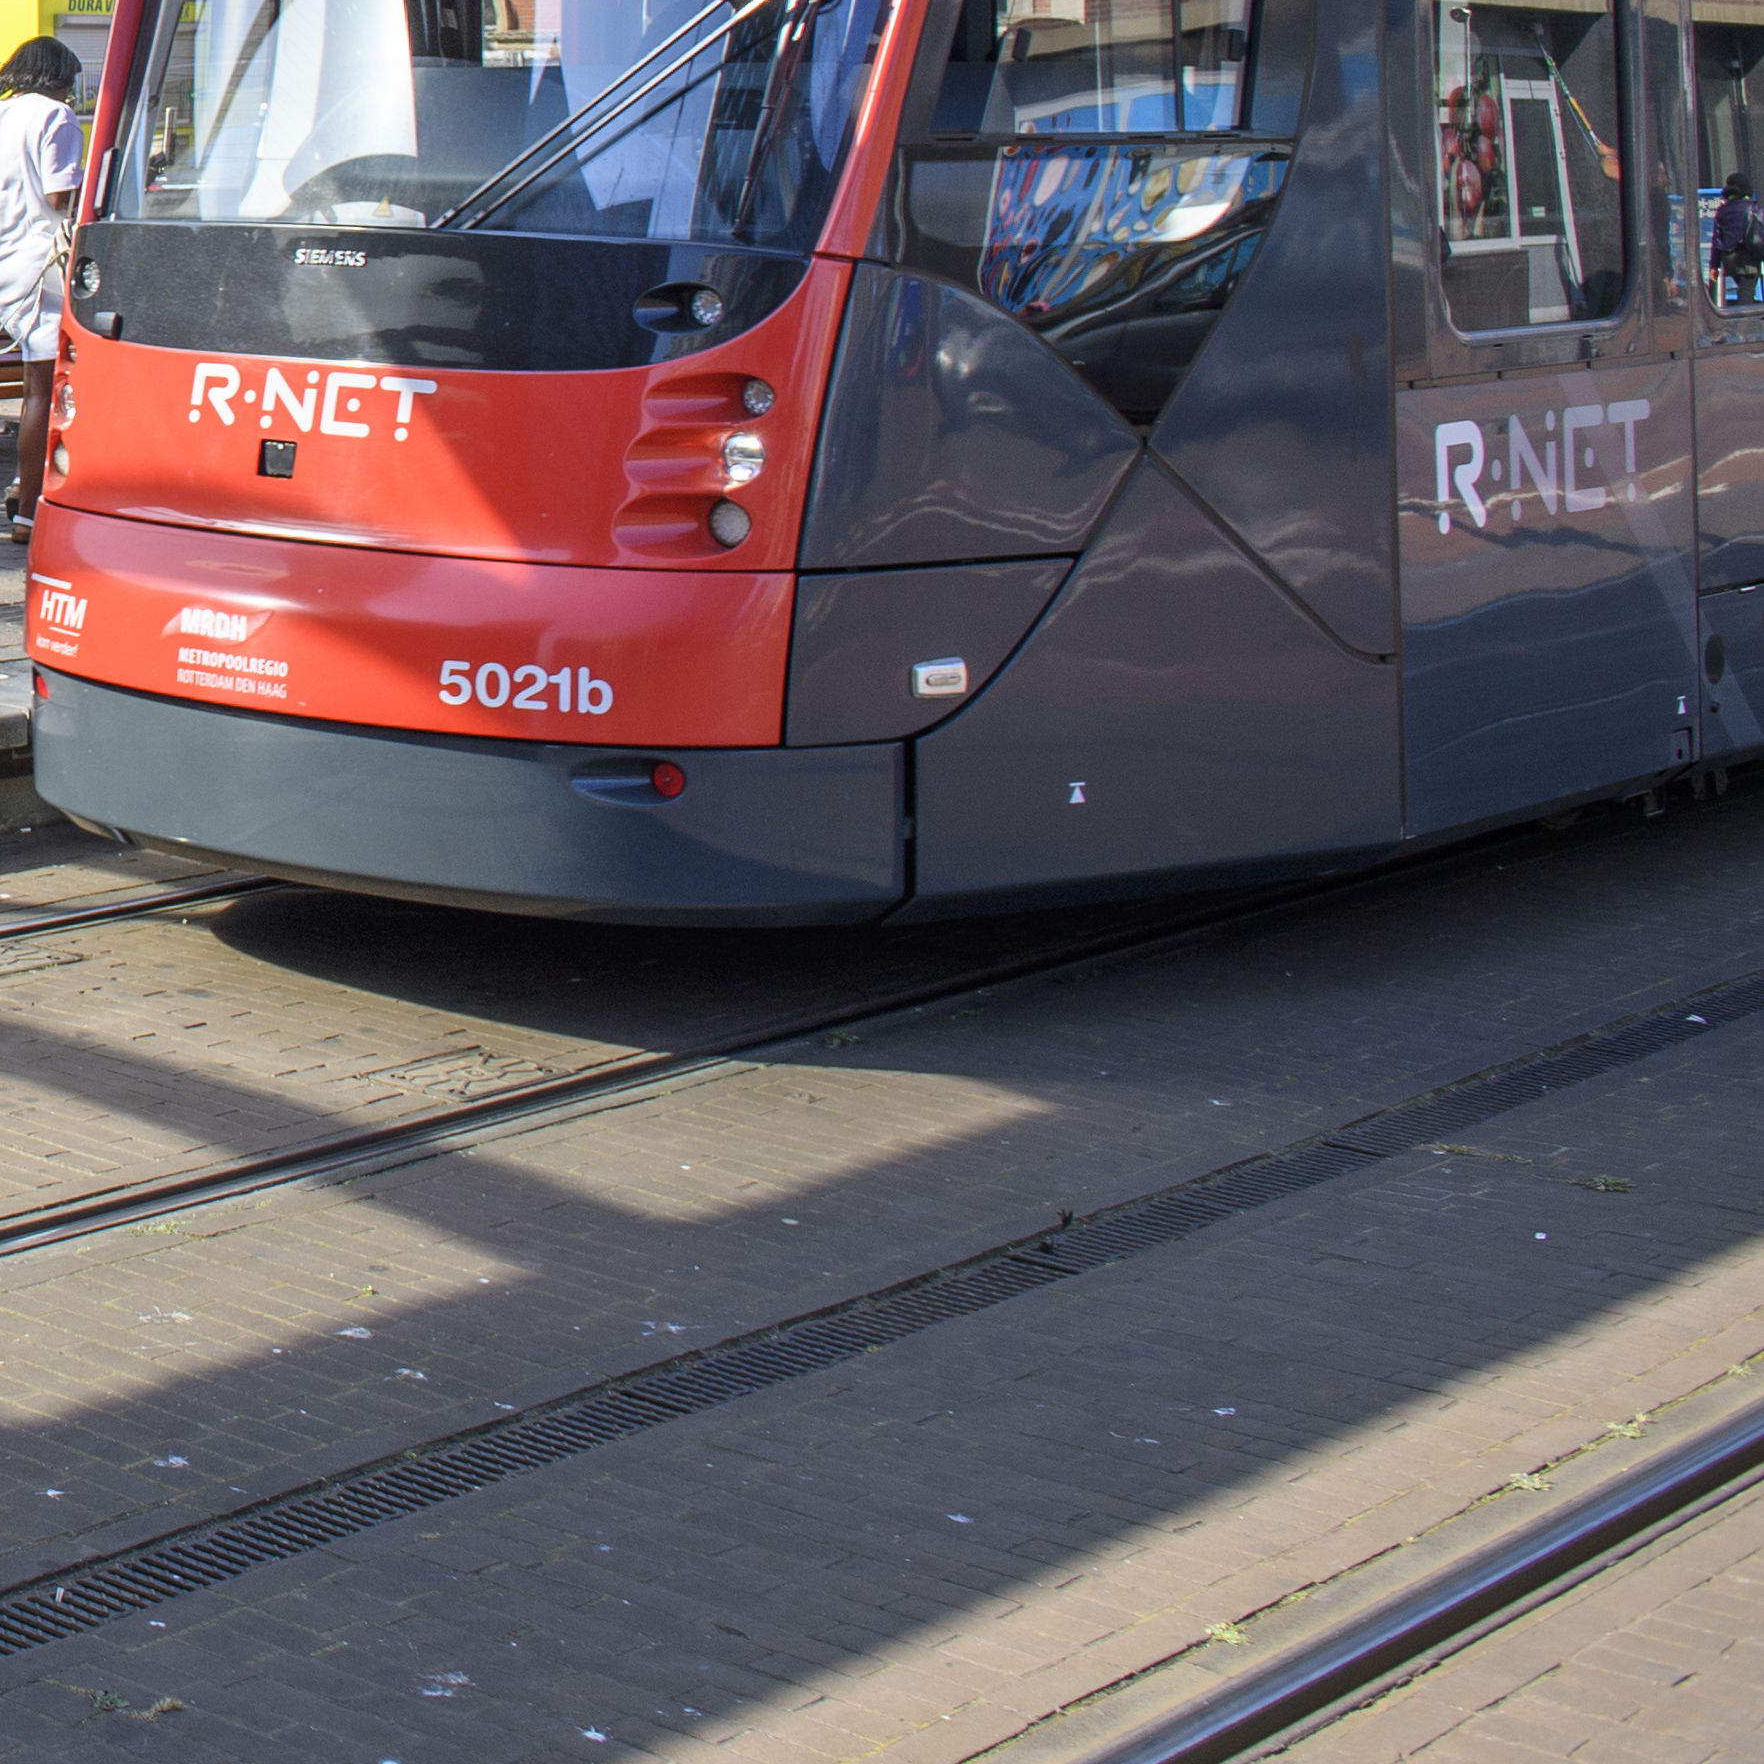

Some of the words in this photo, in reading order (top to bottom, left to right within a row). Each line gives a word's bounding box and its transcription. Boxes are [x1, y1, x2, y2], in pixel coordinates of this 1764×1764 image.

[294, 248, 367, 267] SIEMENS
[39, 589, 88, 629] HTM
[180, 607, 247, 642] MRDH
[177, 647, 289, 678] METROPOOLREGIO
[176, 668, 235, 691] ROTTERDAM
[235, 677, 257, 694] DEN
[257, 680, 288, 699] HAAG
[438, 660, 614, 715] 5021b
